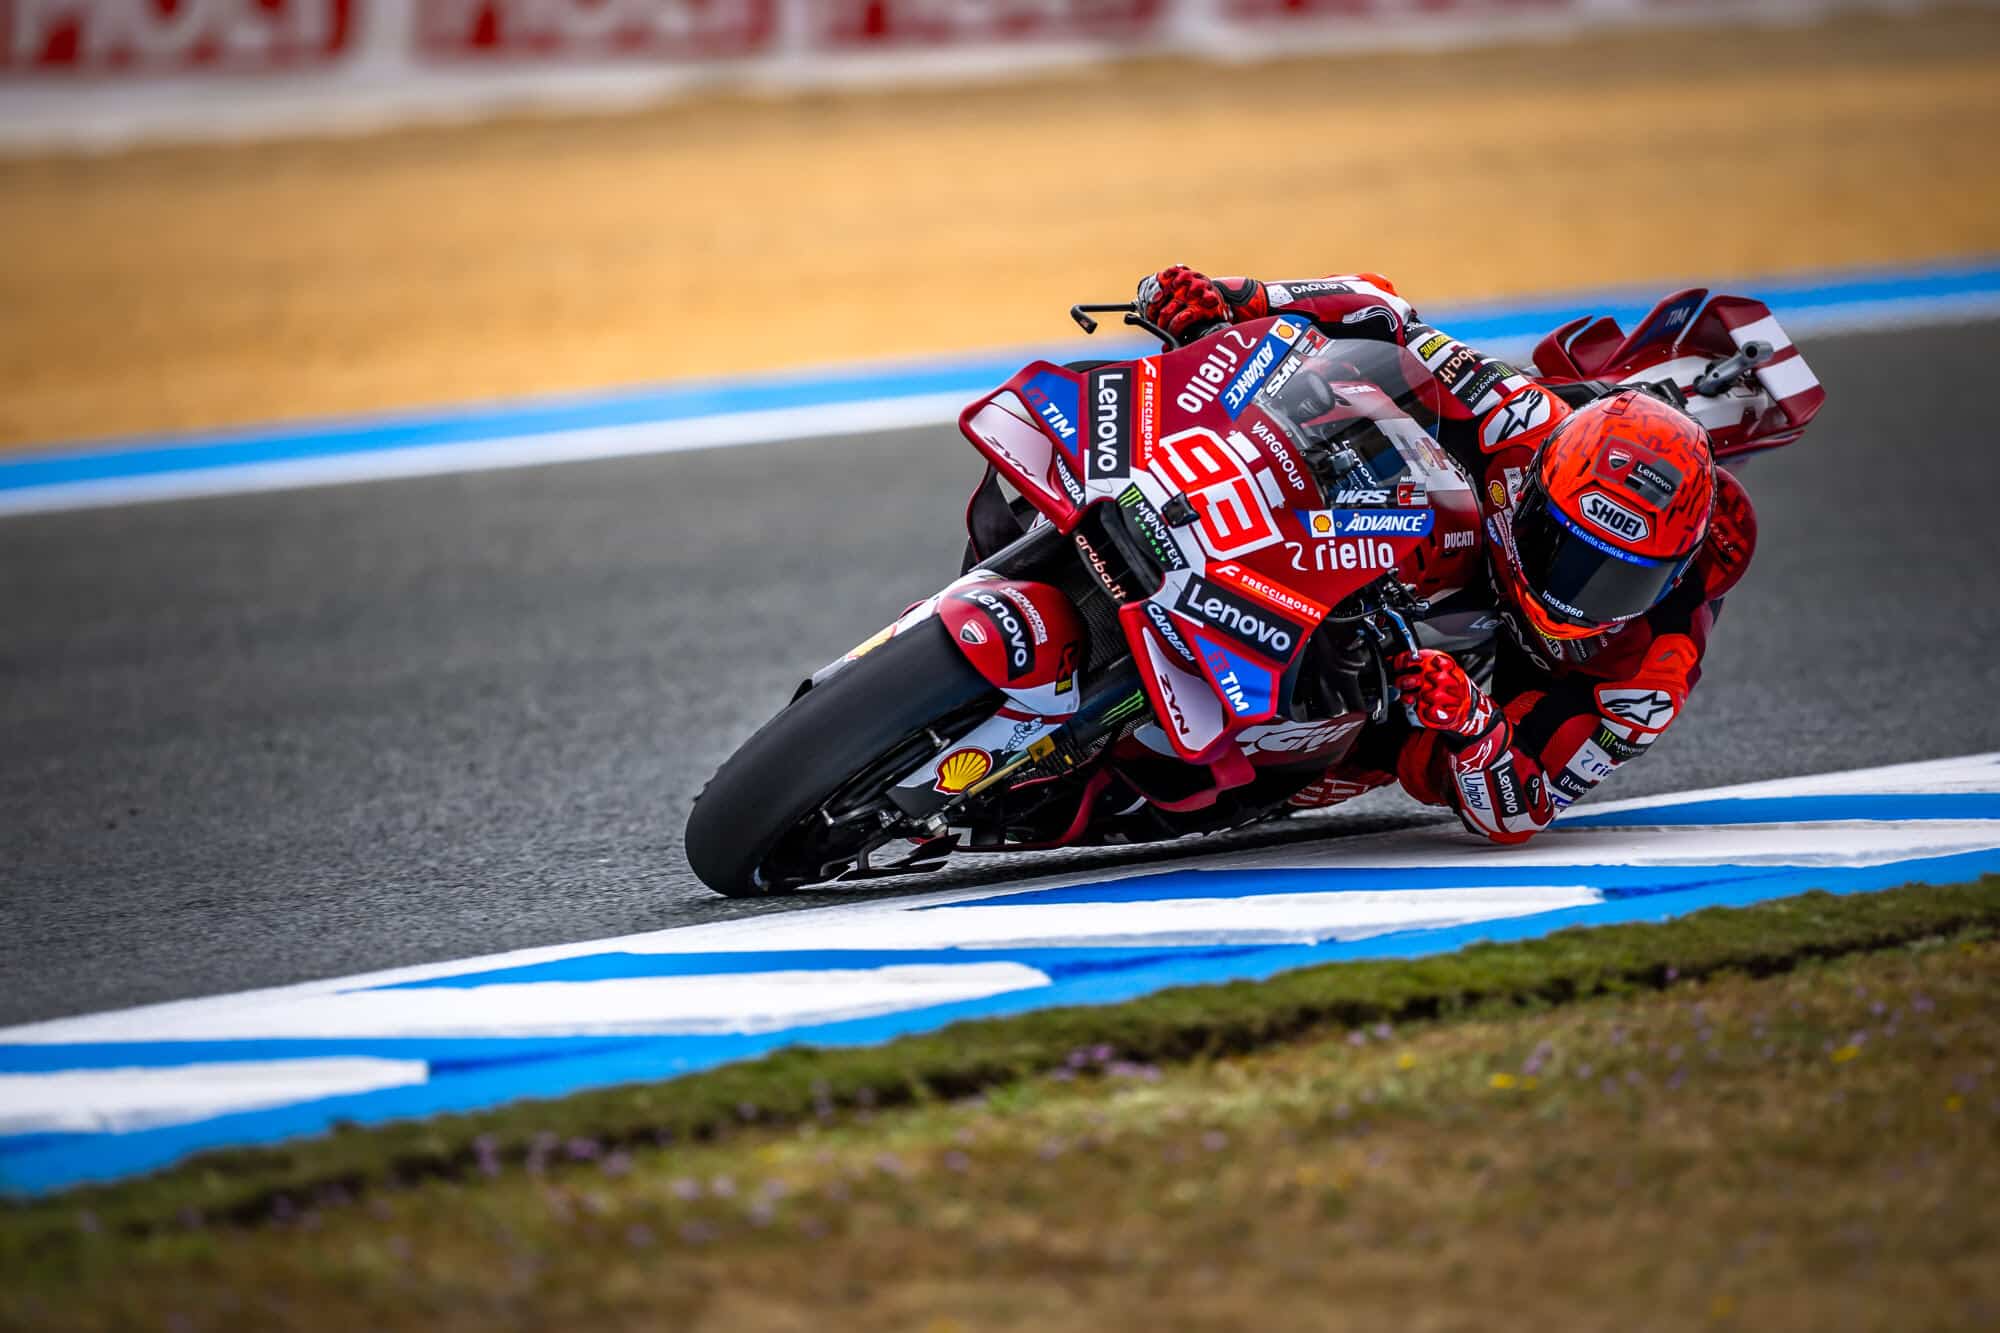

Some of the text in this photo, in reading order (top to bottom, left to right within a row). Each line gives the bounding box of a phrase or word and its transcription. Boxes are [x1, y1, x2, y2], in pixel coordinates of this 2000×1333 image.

[1291, 281, 1349, 294] Lenovo
[1665, 306, 1691, 327] TIM
[1176, 344, 1238, 413] riello
[1225, 340, 1275, 410] ADVANCE
[1265, 355, 1302, 397] WRS
[1042, 402, 1076, 439] TIM
[1097, 373, 1124, 472] Lenovo
[1144, 381, 1154, 460] FRECCIAROSSA
[983, 435, 1035, 477] ZYN
[1250, 421, 1305, 491] VARGROUP
[1637, 463, 1672, 491] Lenovo
[1056, 454, 1085, 504] CARRERA
[1152, 428, 1281, 559] 93
[1336, 489, 1391, 503] WRS
[1135, 502, 1183, 570] MONSTER
[1344, 514, 1424, 532] ADVANCE
[1588, 498, 1642, 537] SHOEI
[1315, 538, 1394, 571] riello
[1444, 531, 1475, 549] DUCATI
[1076, 535, 1127, 600] aruba.it
[1187, 584, 1291, 652] Lenovo
[1241, 575, 1322, 620] FRECCIAROSSA
[1542, 590, 1584, 618] Insta360
[964, 589, 1027, 668] Lenovo
[1159, 673, 1190, 735] ZYN
[1221, 671, 1250, 712] TIM
[1464, 776, 1491, 810] Unipol
[1497, 766, 1519, 813] Lenovo
